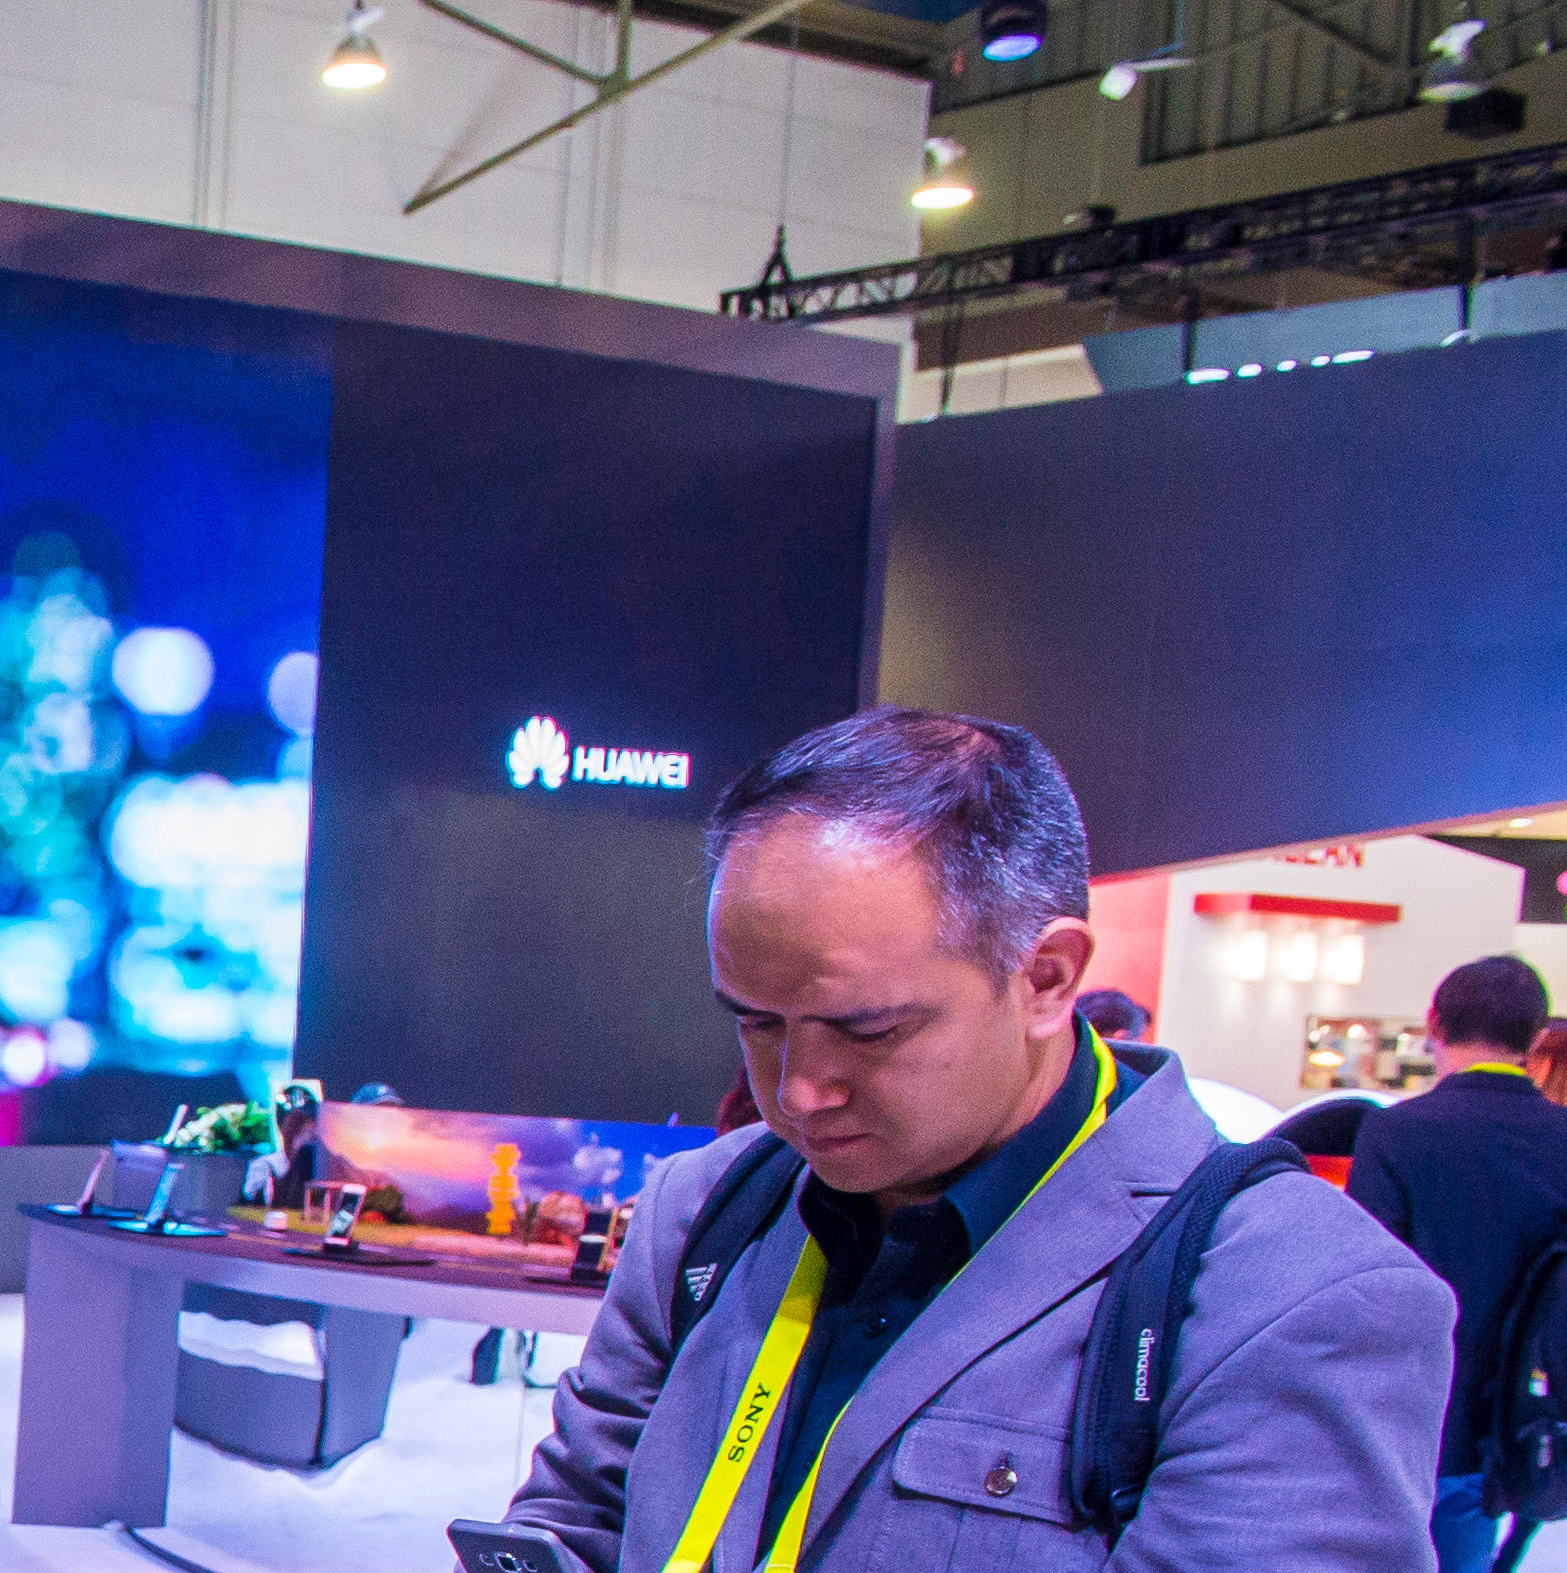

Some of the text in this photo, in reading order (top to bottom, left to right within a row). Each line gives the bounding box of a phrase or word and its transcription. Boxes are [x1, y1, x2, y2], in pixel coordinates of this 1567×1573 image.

[571, 745, 691, 789] HUAWEI
[1134, 1327, 1155, 1402] climacool
[727, 1382, 772, 1463] SONY
